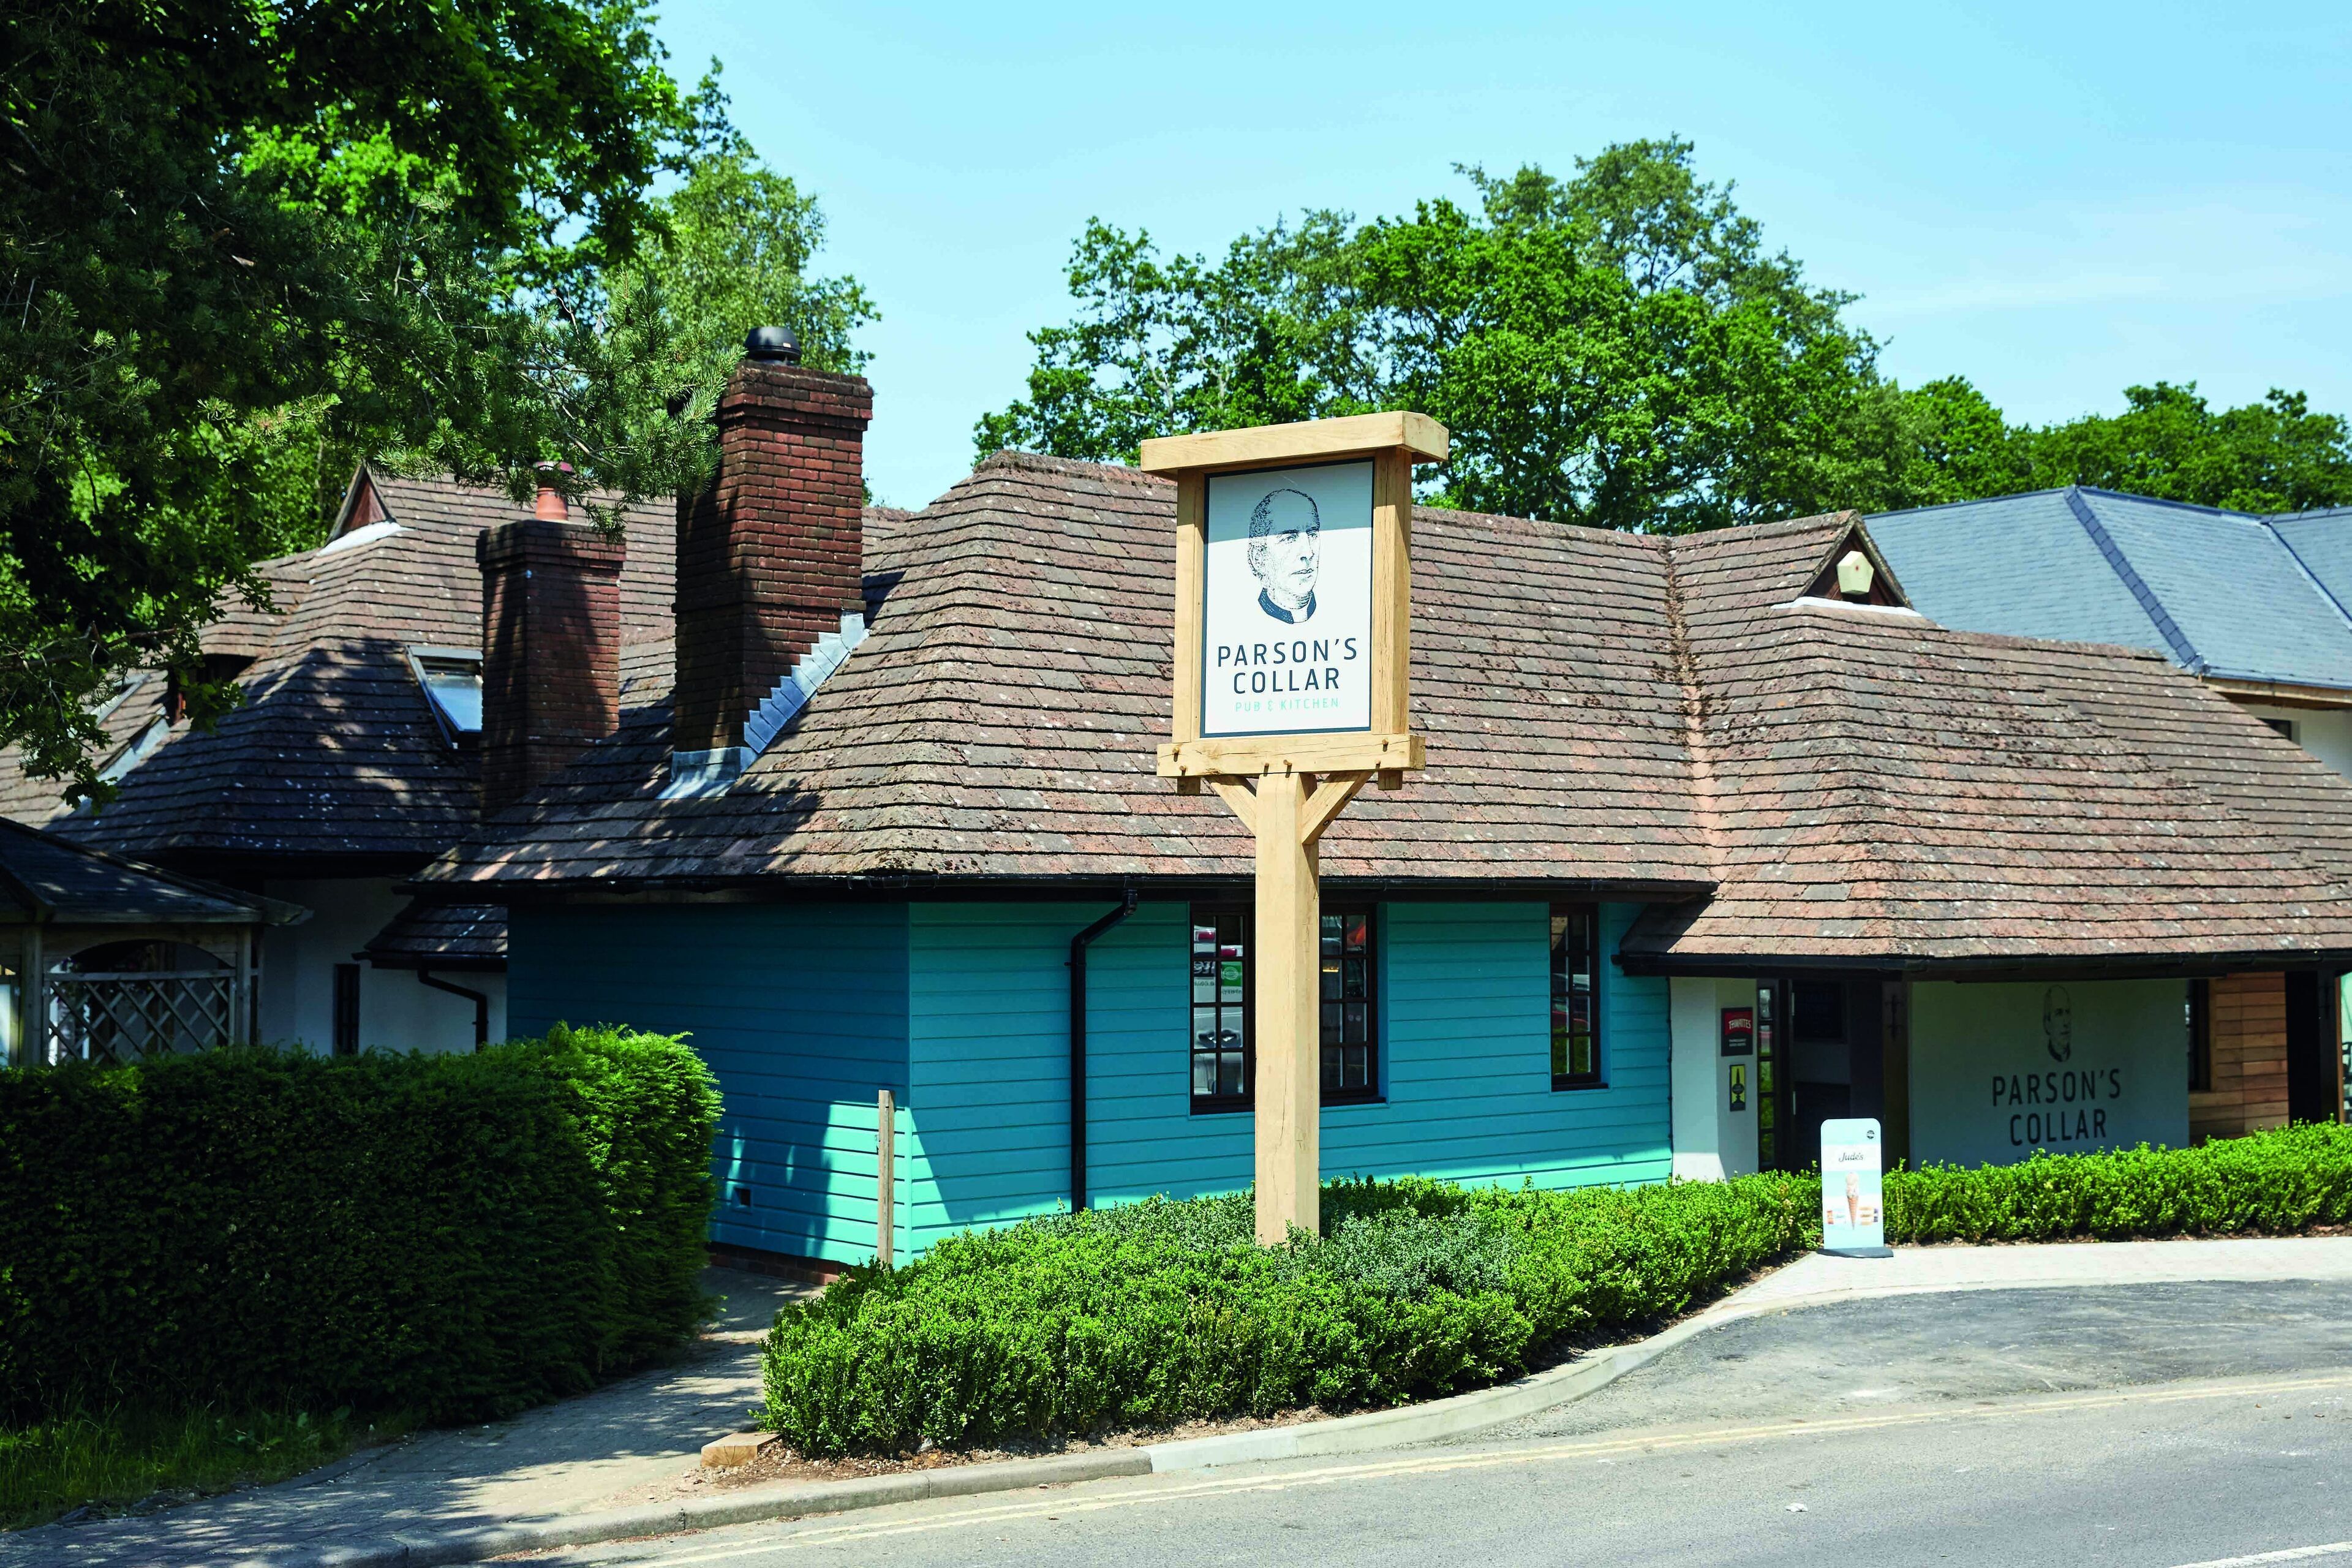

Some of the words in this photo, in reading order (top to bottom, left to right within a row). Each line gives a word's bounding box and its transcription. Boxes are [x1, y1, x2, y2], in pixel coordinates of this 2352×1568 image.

[1218, 638, 1357, 667] PARSON'S
[1234, 668, 1340, 694] COLLAR
[1235, 701, 1261, 712] PUB
[1267, 699, 1274, 712] &
[1280, 697, 1339, 710] KITCHEN
[1992, 1068, 2122, 1106] PARSON'S
[2010, 1109, 2106, 1146] COLLAR
[1838, 1152, 1864, 1163] Jude's
